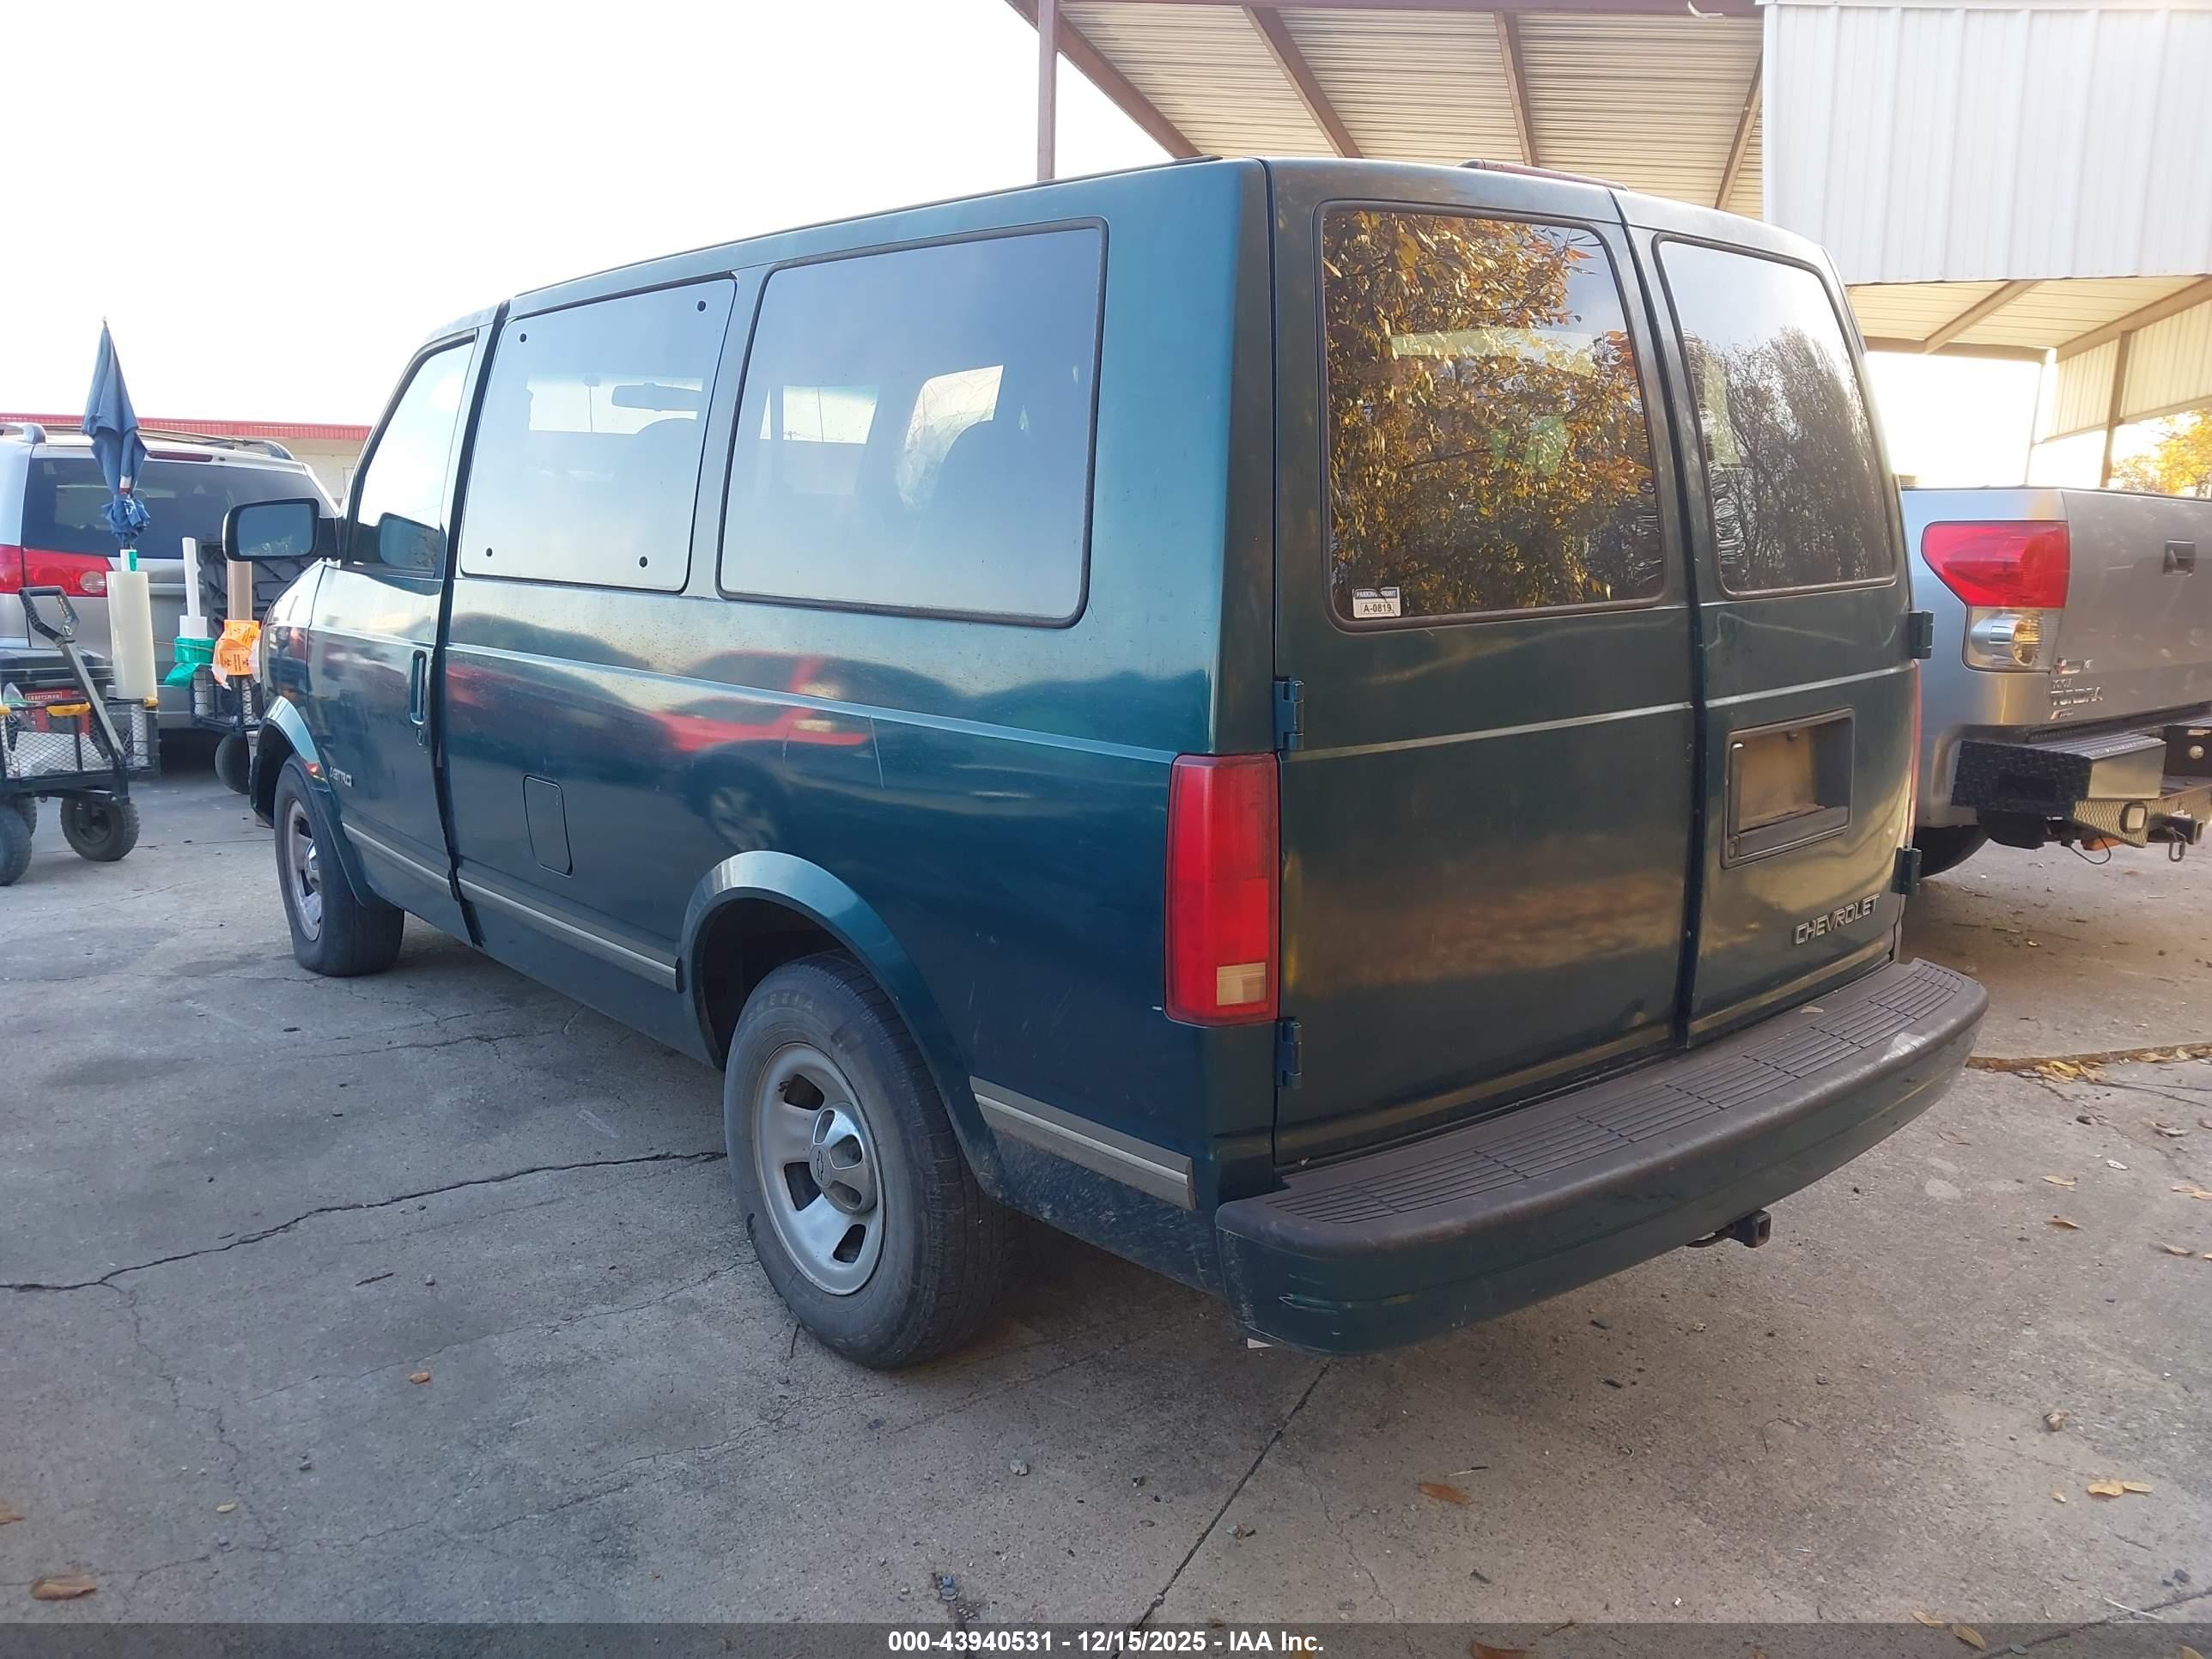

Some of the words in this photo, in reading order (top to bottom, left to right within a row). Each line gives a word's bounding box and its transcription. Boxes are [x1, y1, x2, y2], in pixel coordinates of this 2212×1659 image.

[1364, 604, 1392, 613] A-0819
[2051, 686, 2103, 706] TUNDRA
[1794, 893, 1881, 945] CHEVROLET
